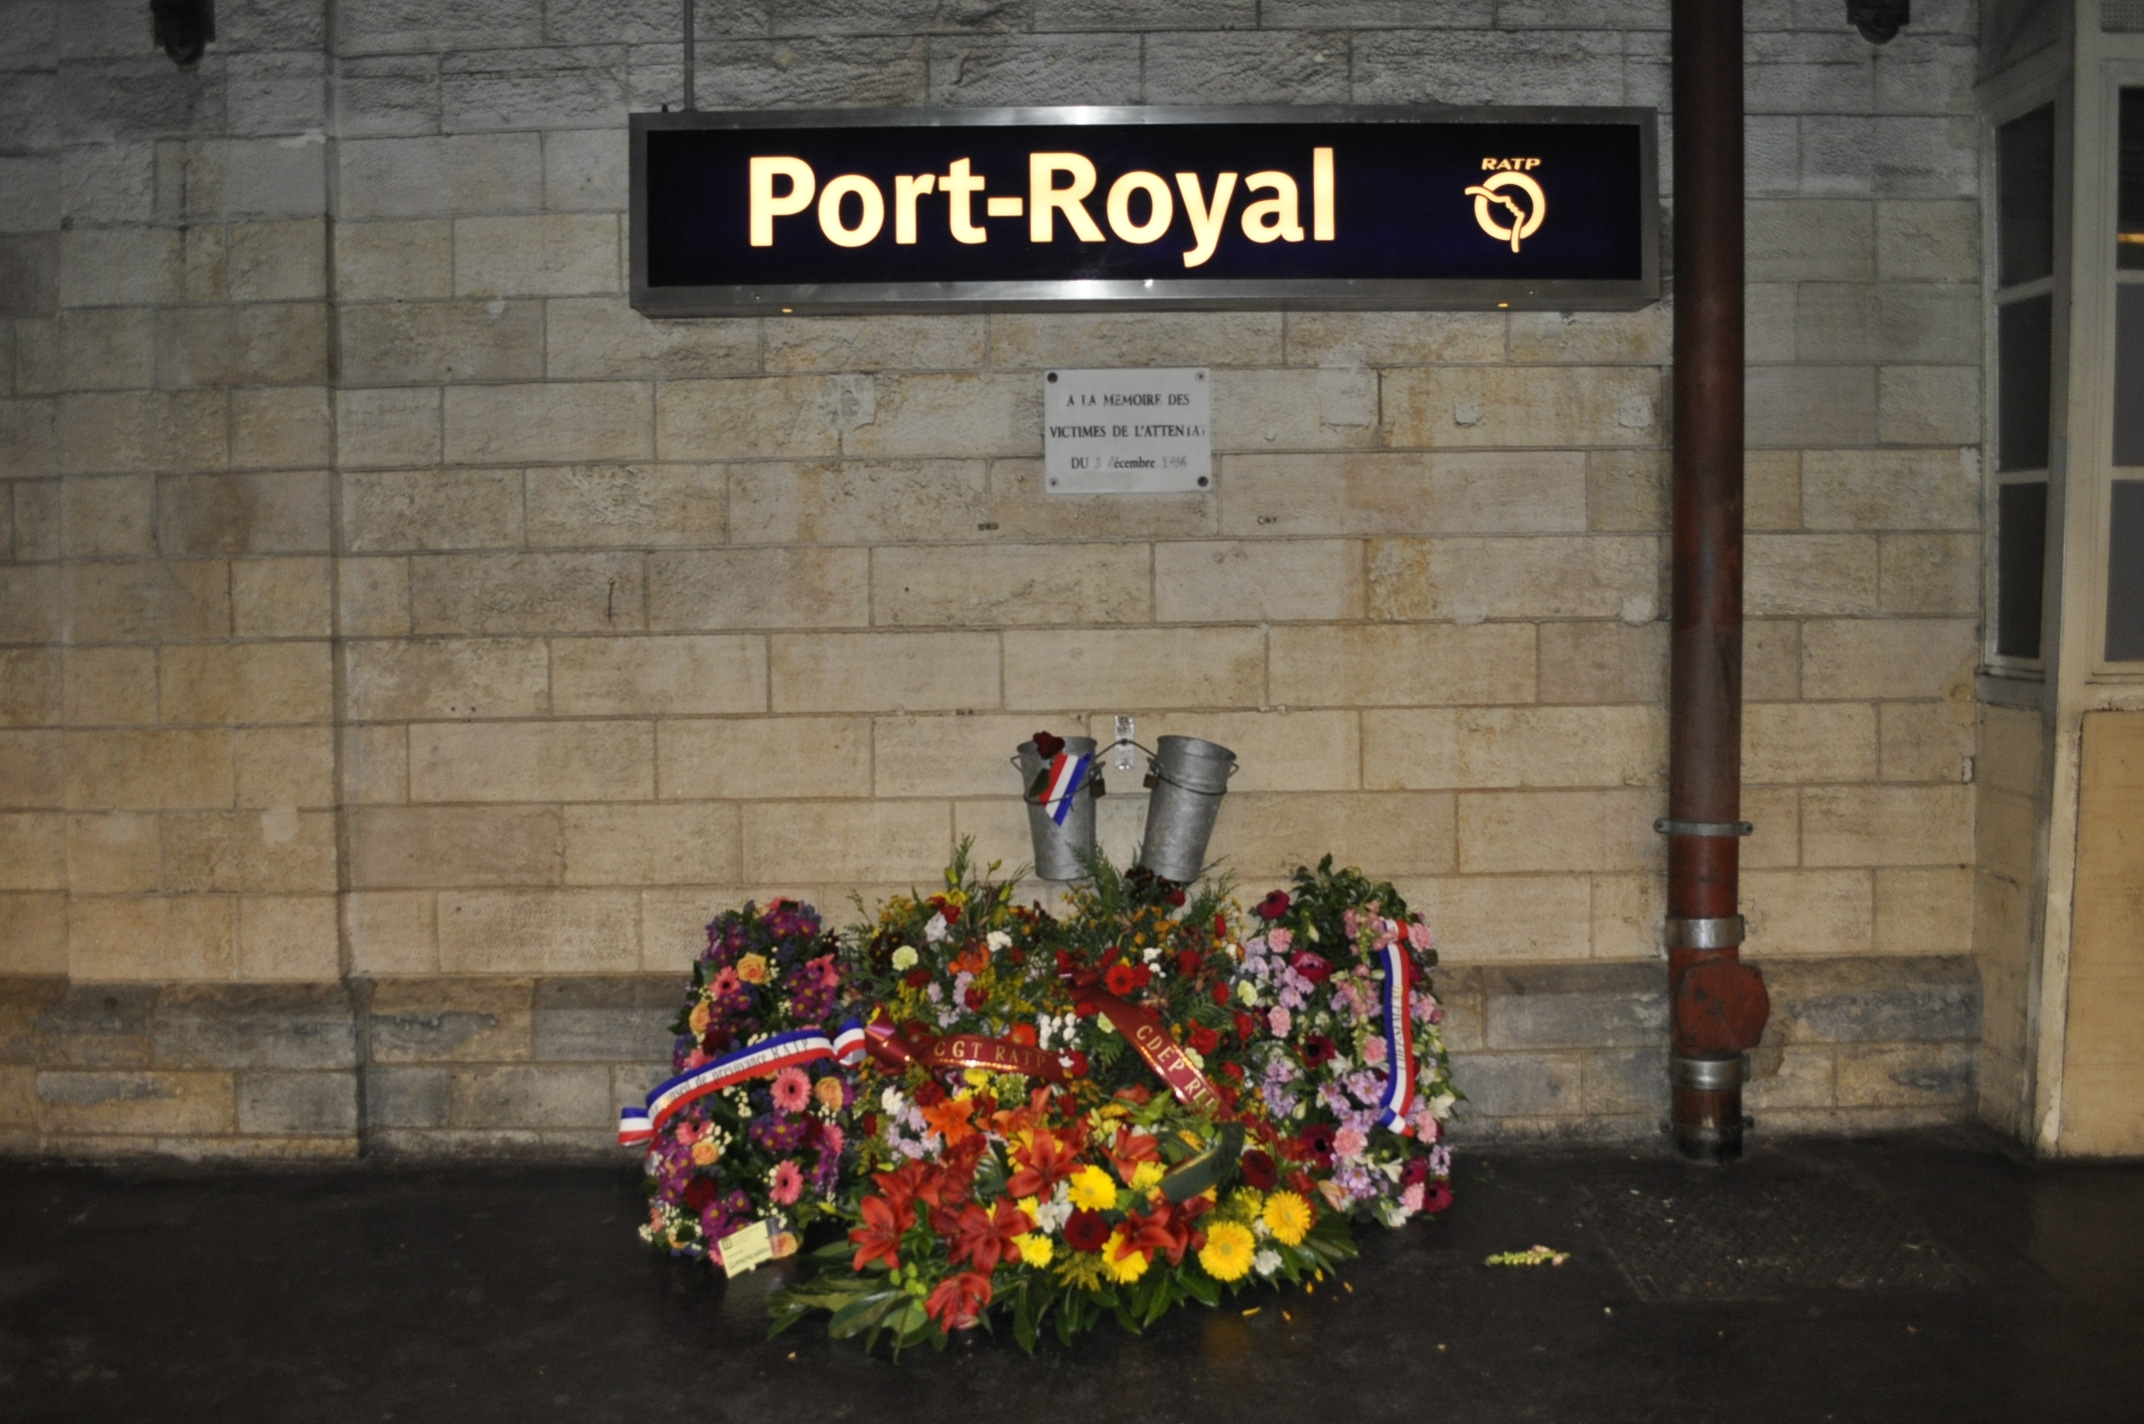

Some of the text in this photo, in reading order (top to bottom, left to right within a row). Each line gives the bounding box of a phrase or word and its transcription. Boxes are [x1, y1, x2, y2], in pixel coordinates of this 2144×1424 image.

[1481, 157, 1542, 171] RATP
[749, 147, 1335, 268] Port-Royal
[1066, 394, 1075, 407] A
[1168, 393, 1190, 406] DES
[1050, 425, 1106, 438] VICTIMES
[1113, 425, 1128, 438] DE
[1071, 456, 1089, 470] DU
[771, 1038, 809, 1059] RATP
[934, 1040, 1046, 1069] CGT RATP
[1136, 1024, 1185, 1073] CDEP
